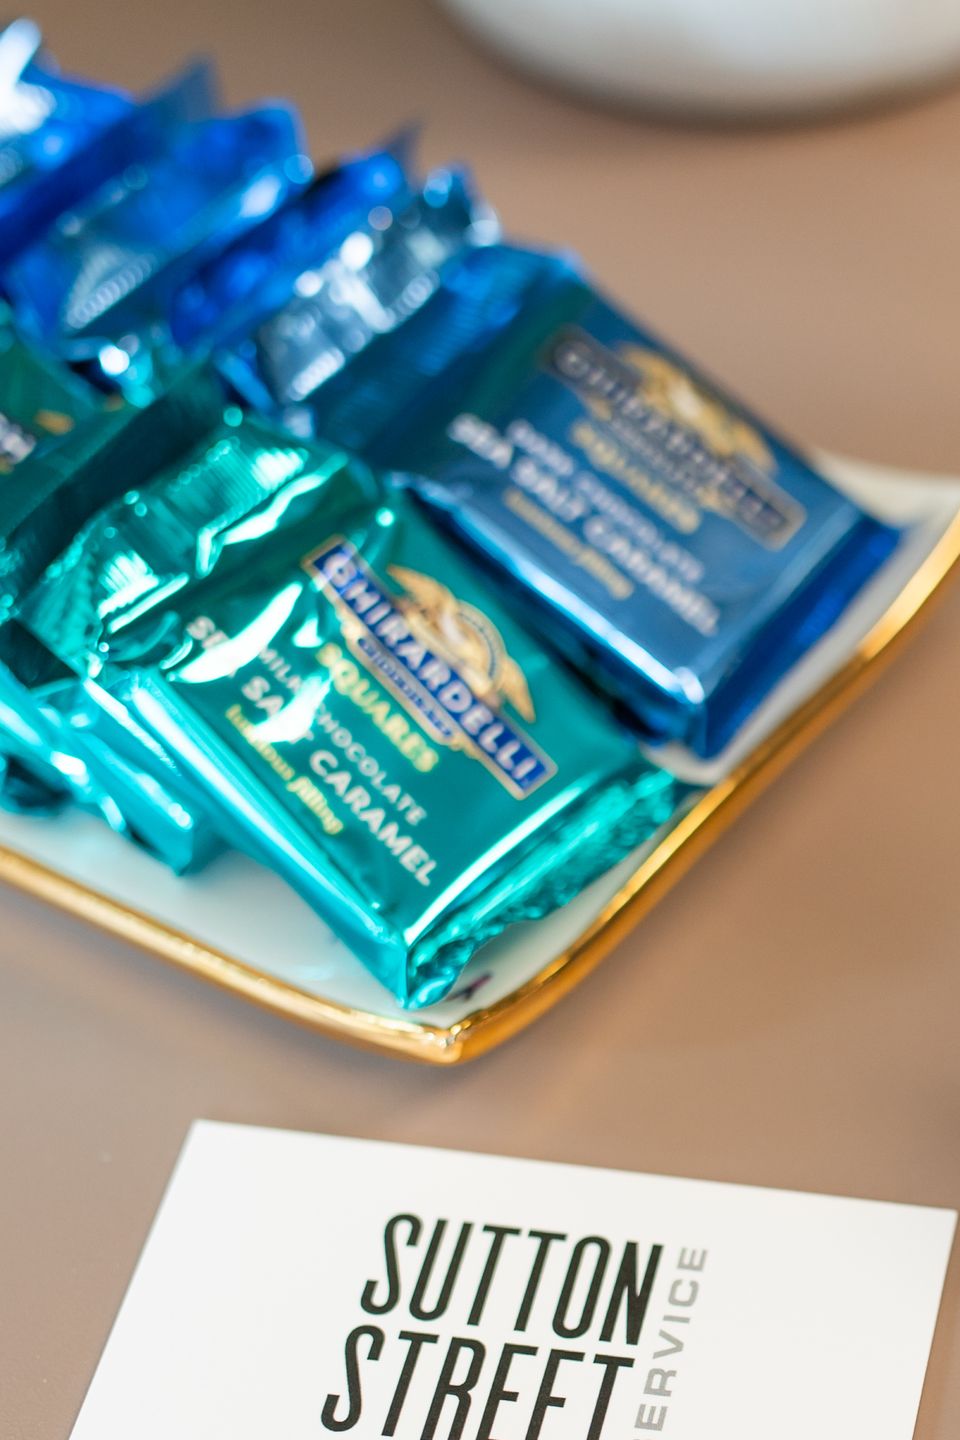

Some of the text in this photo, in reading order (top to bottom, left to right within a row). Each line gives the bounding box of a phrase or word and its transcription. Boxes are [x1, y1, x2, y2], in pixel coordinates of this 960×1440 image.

[316, 642, 439, 772] SQUARES
[323, 552, 541, 782] GHIRARDELLI
[309, 750, 437, 887] CARAMEL
[360, 1213, 664, 1346] SUTTON
